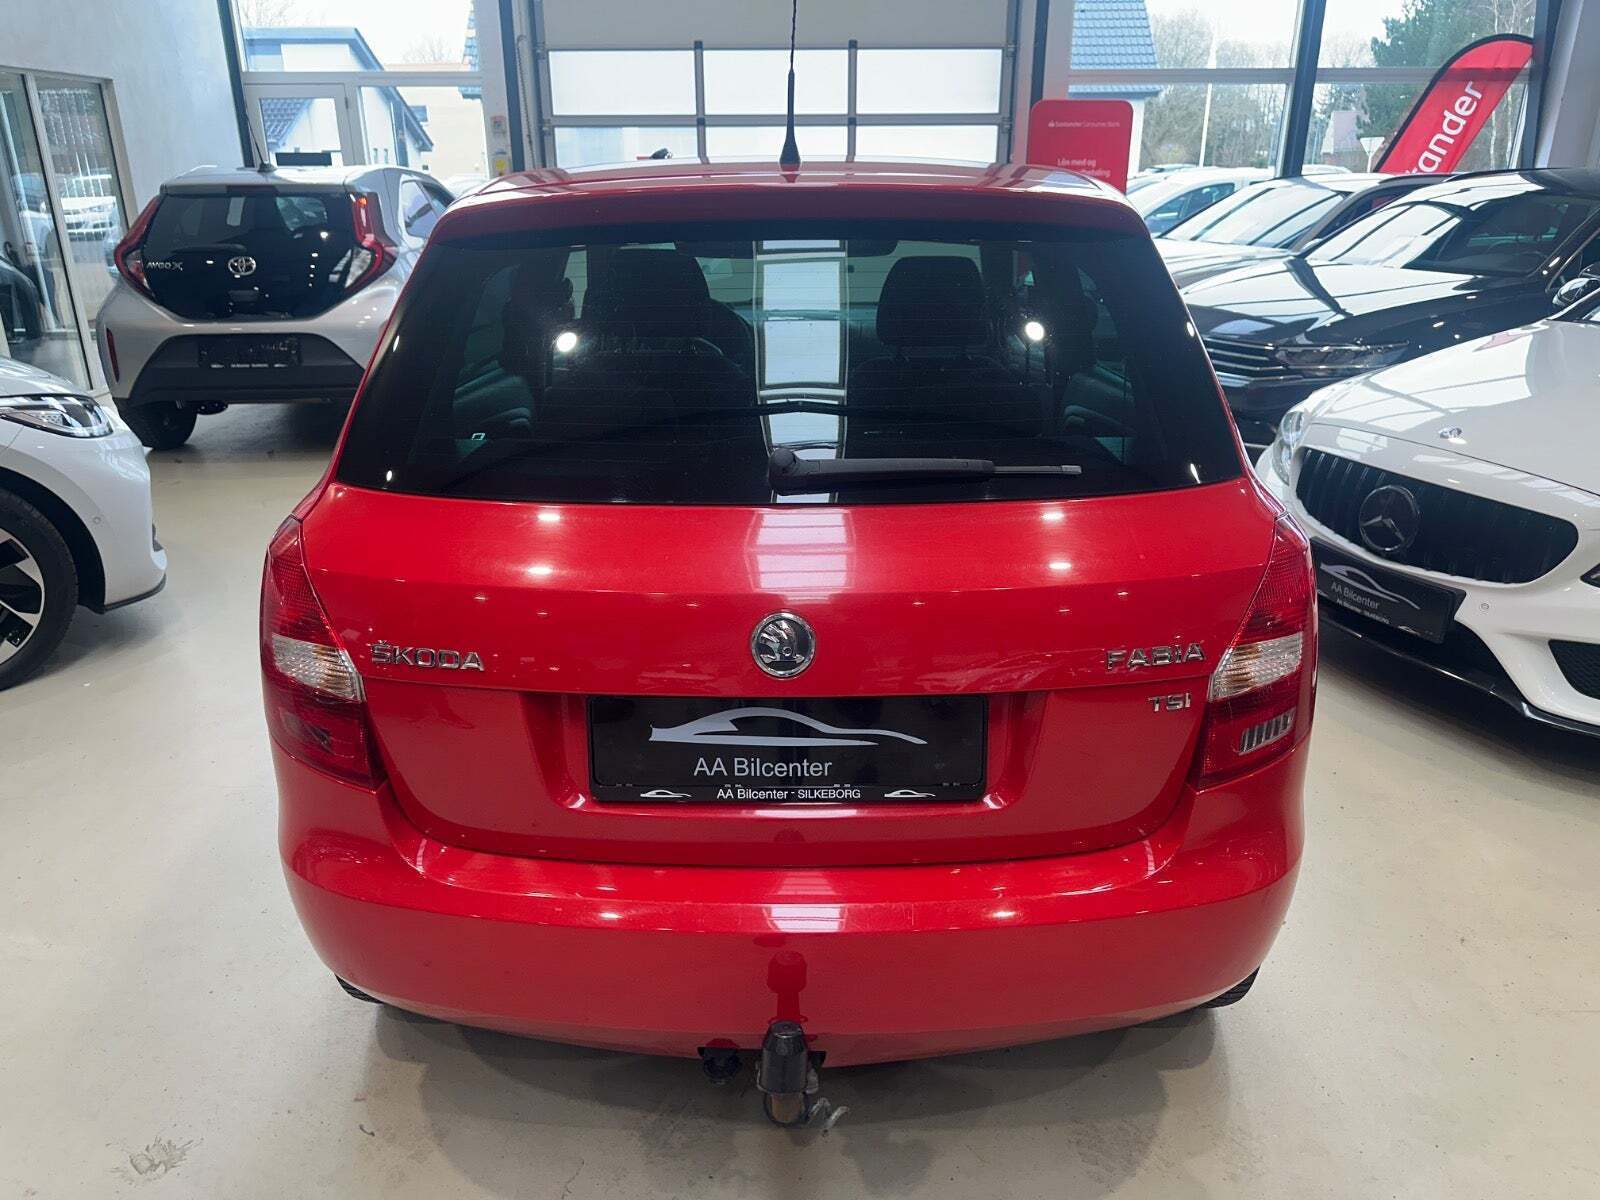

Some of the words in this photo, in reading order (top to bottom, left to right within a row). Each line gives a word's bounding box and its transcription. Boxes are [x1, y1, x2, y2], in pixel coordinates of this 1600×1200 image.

[1331, 581, 1342, 594] AA
[1343, 587, 1380, 609] Bilcenter
[371, 639, 485, 672] ŠKODA
[1105, 642, 1205, 671] FABIA
[1147, 692, 1191, 712] TSI
[693, 757, 728, 777] AA
[734, 757, 832, 777] Bilcenter
[717, 788, 734, 800] AA
[737, 788, 788, 800] Bilcenter
[797, 788, 861, 800] SILKEBORG
